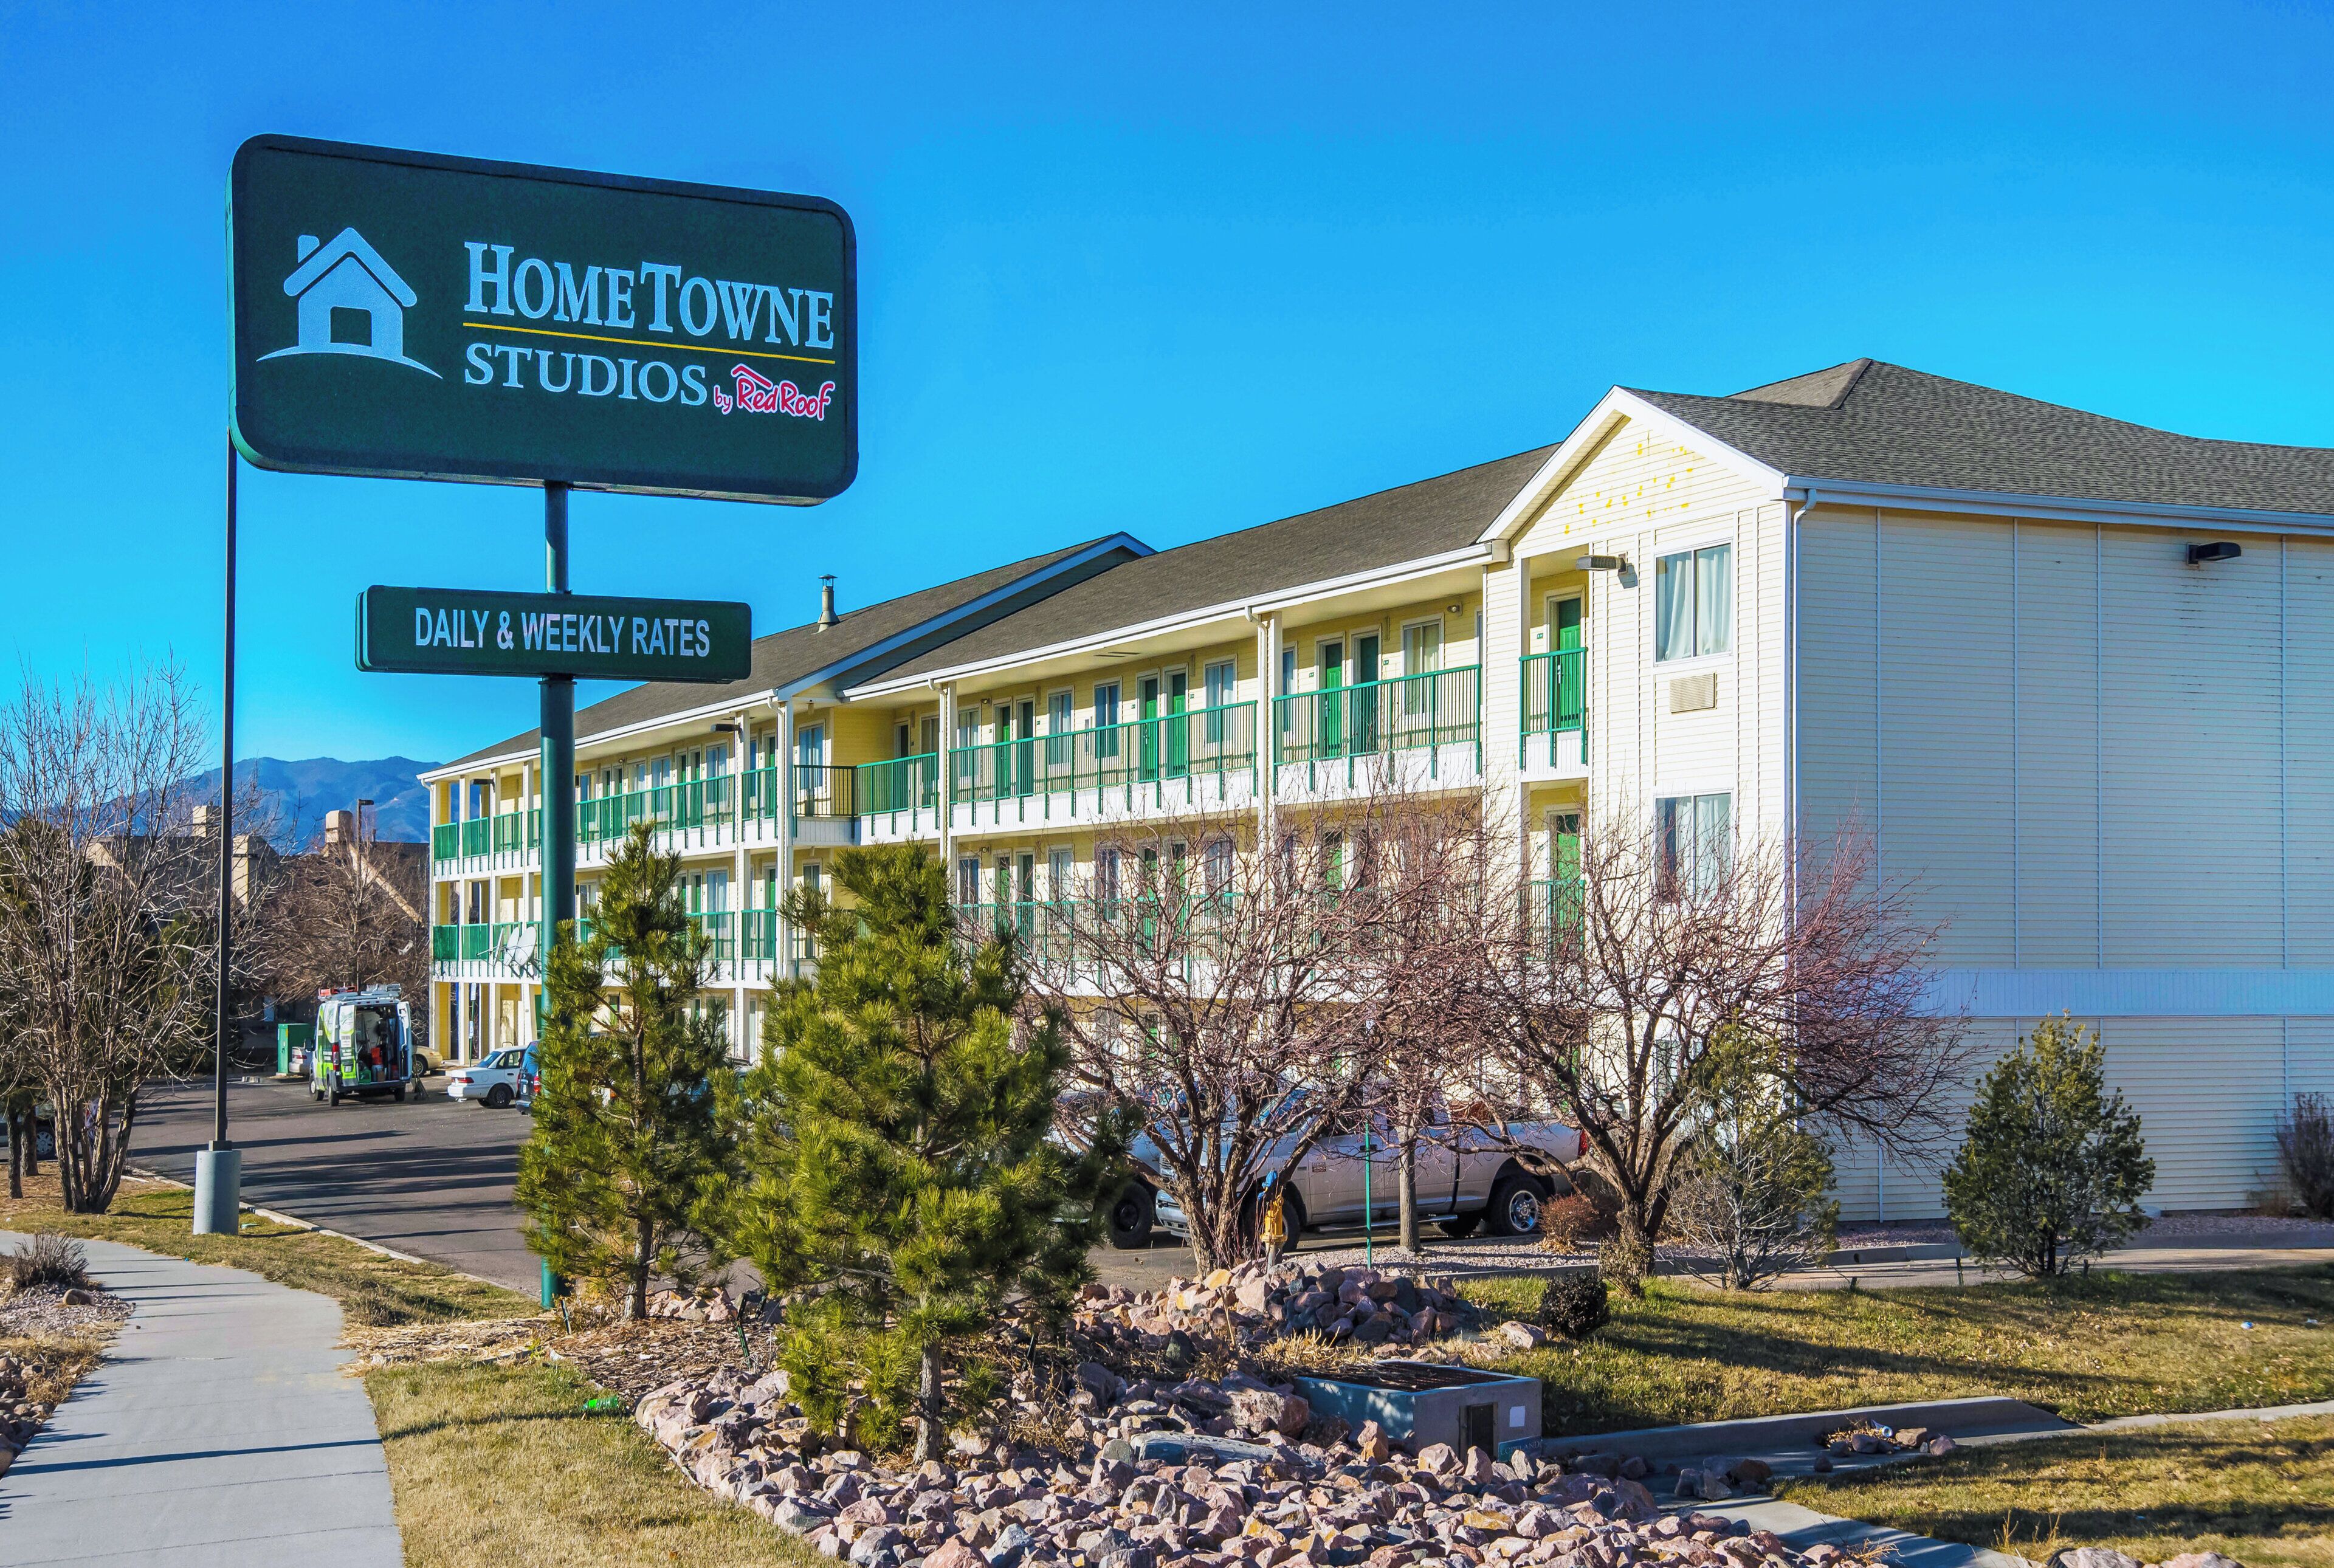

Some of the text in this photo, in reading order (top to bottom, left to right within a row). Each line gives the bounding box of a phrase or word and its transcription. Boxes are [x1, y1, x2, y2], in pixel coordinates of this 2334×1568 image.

[464, 343, 707, 406] STUDIOS
[714, 385, 734, 415] by
[415, 607, 710, 657] DAILY & WEEKLY RATES
